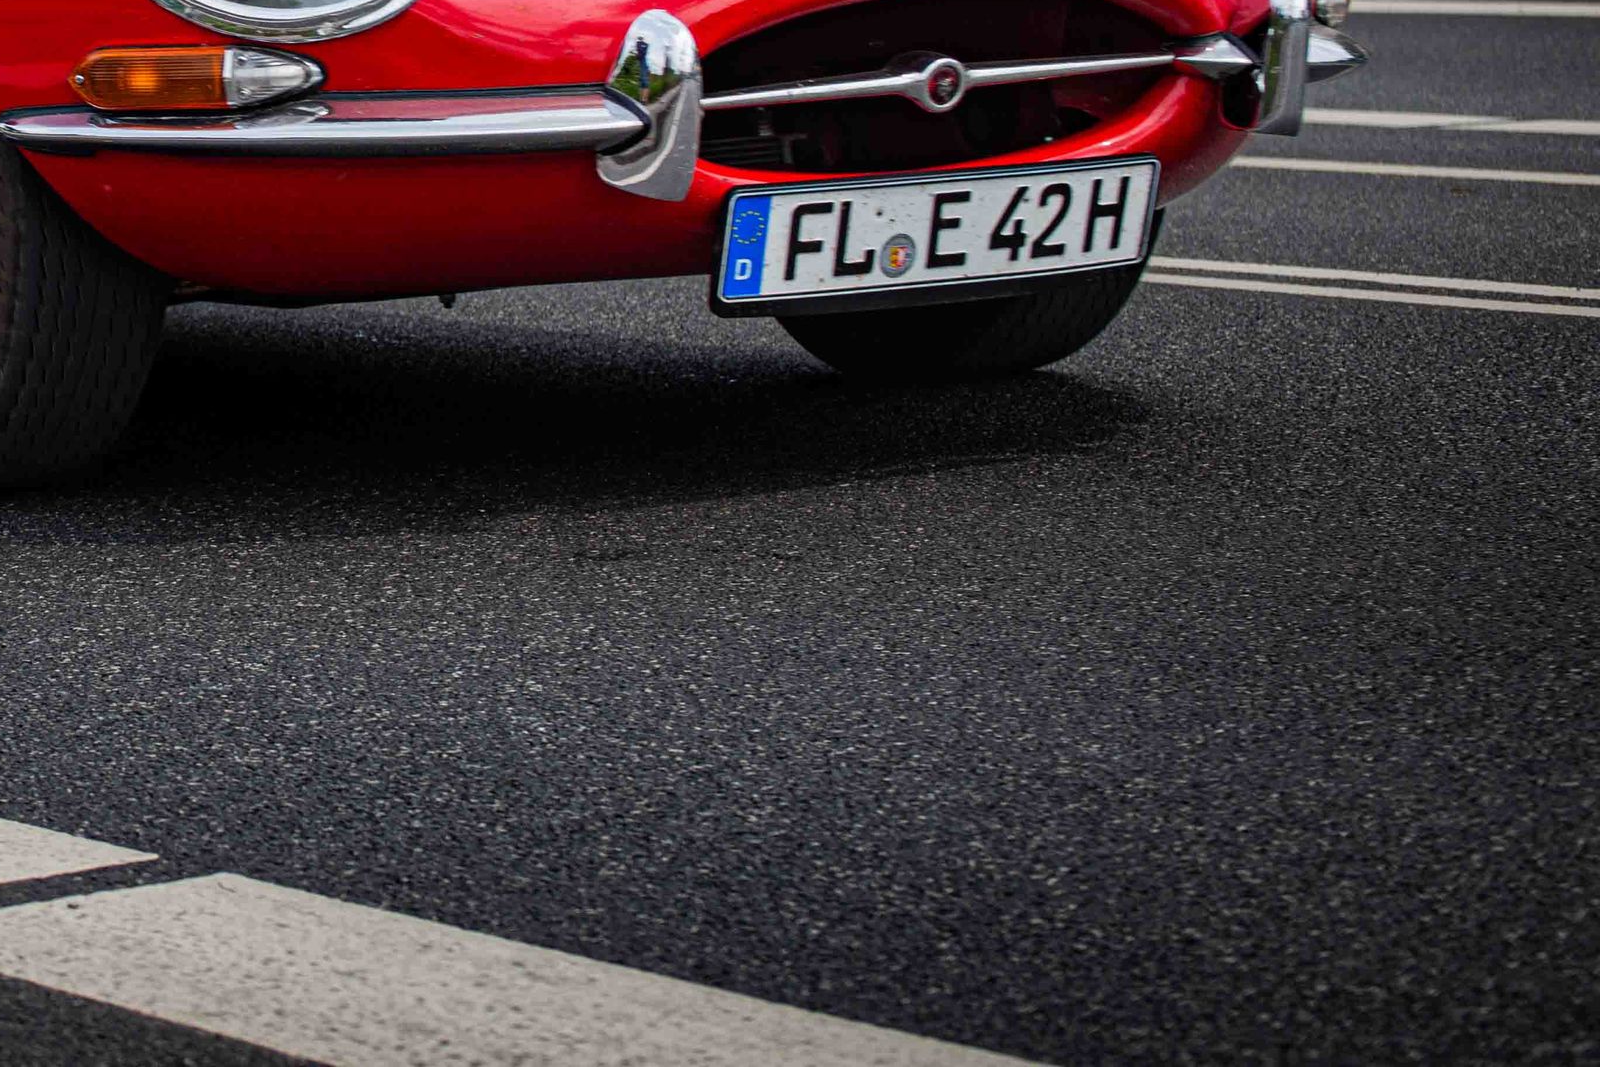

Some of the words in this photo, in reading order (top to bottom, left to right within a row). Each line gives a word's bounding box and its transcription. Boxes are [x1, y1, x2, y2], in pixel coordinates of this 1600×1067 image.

[784, 201, 876, 281] FL
[925, 191, 972, 268] E
[988, 176, 1131, 262] 42H
[734, 258, 752, 280] D
